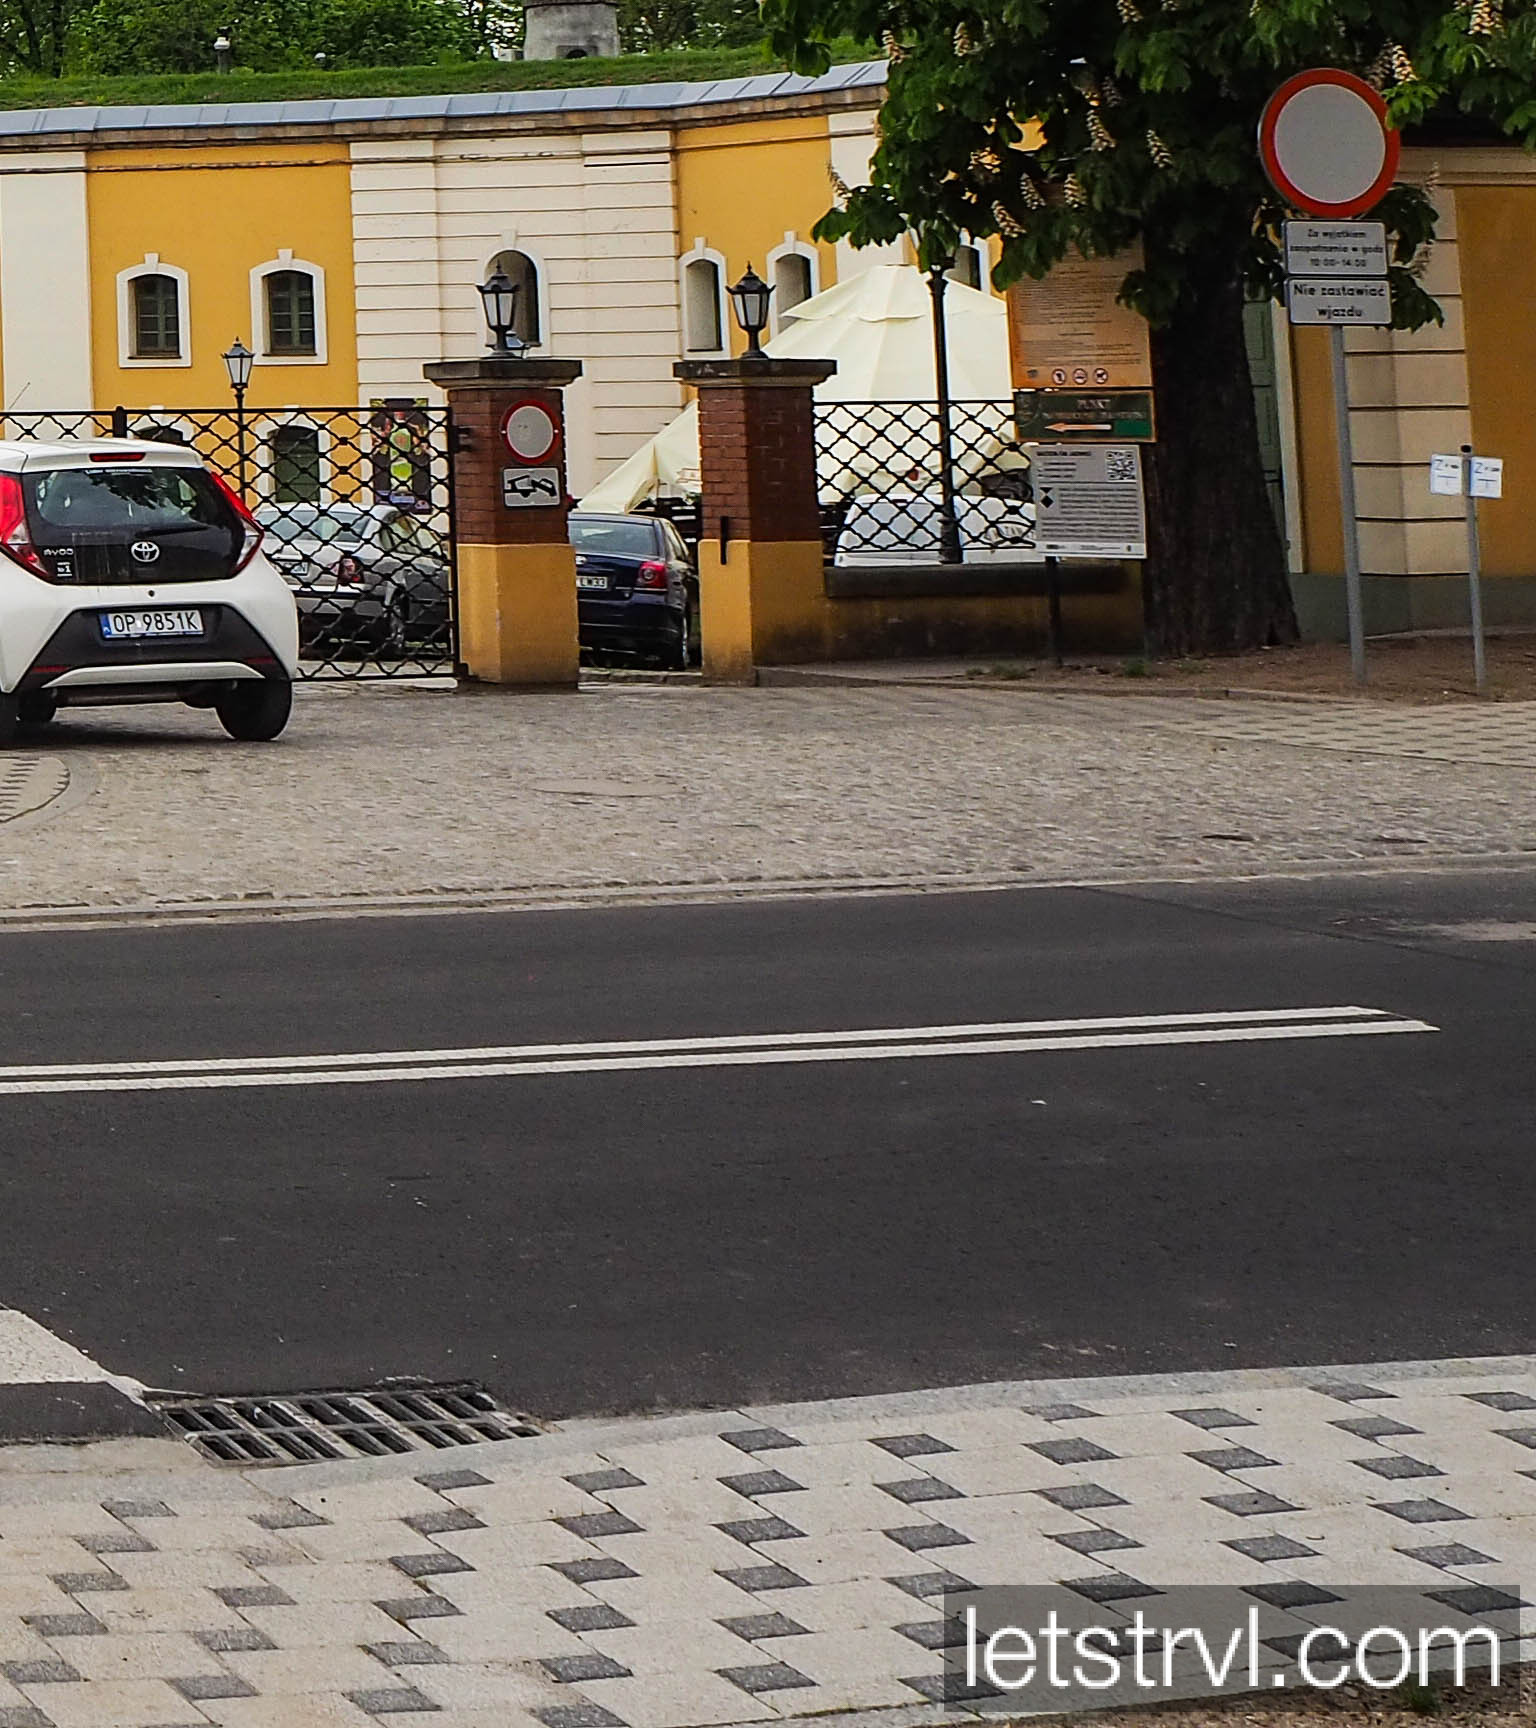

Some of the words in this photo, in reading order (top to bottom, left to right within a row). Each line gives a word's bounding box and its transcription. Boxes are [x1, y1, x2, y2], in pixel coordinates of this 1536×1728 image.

[1294, 284, 1316, 296] Nie
[1320, 284, 1386, 297] zastawiać
[1317, 306, 1363, 319] wjazdu
[113, 614, 136, 633] OP
[143, 611, 198, 632] 9851K
